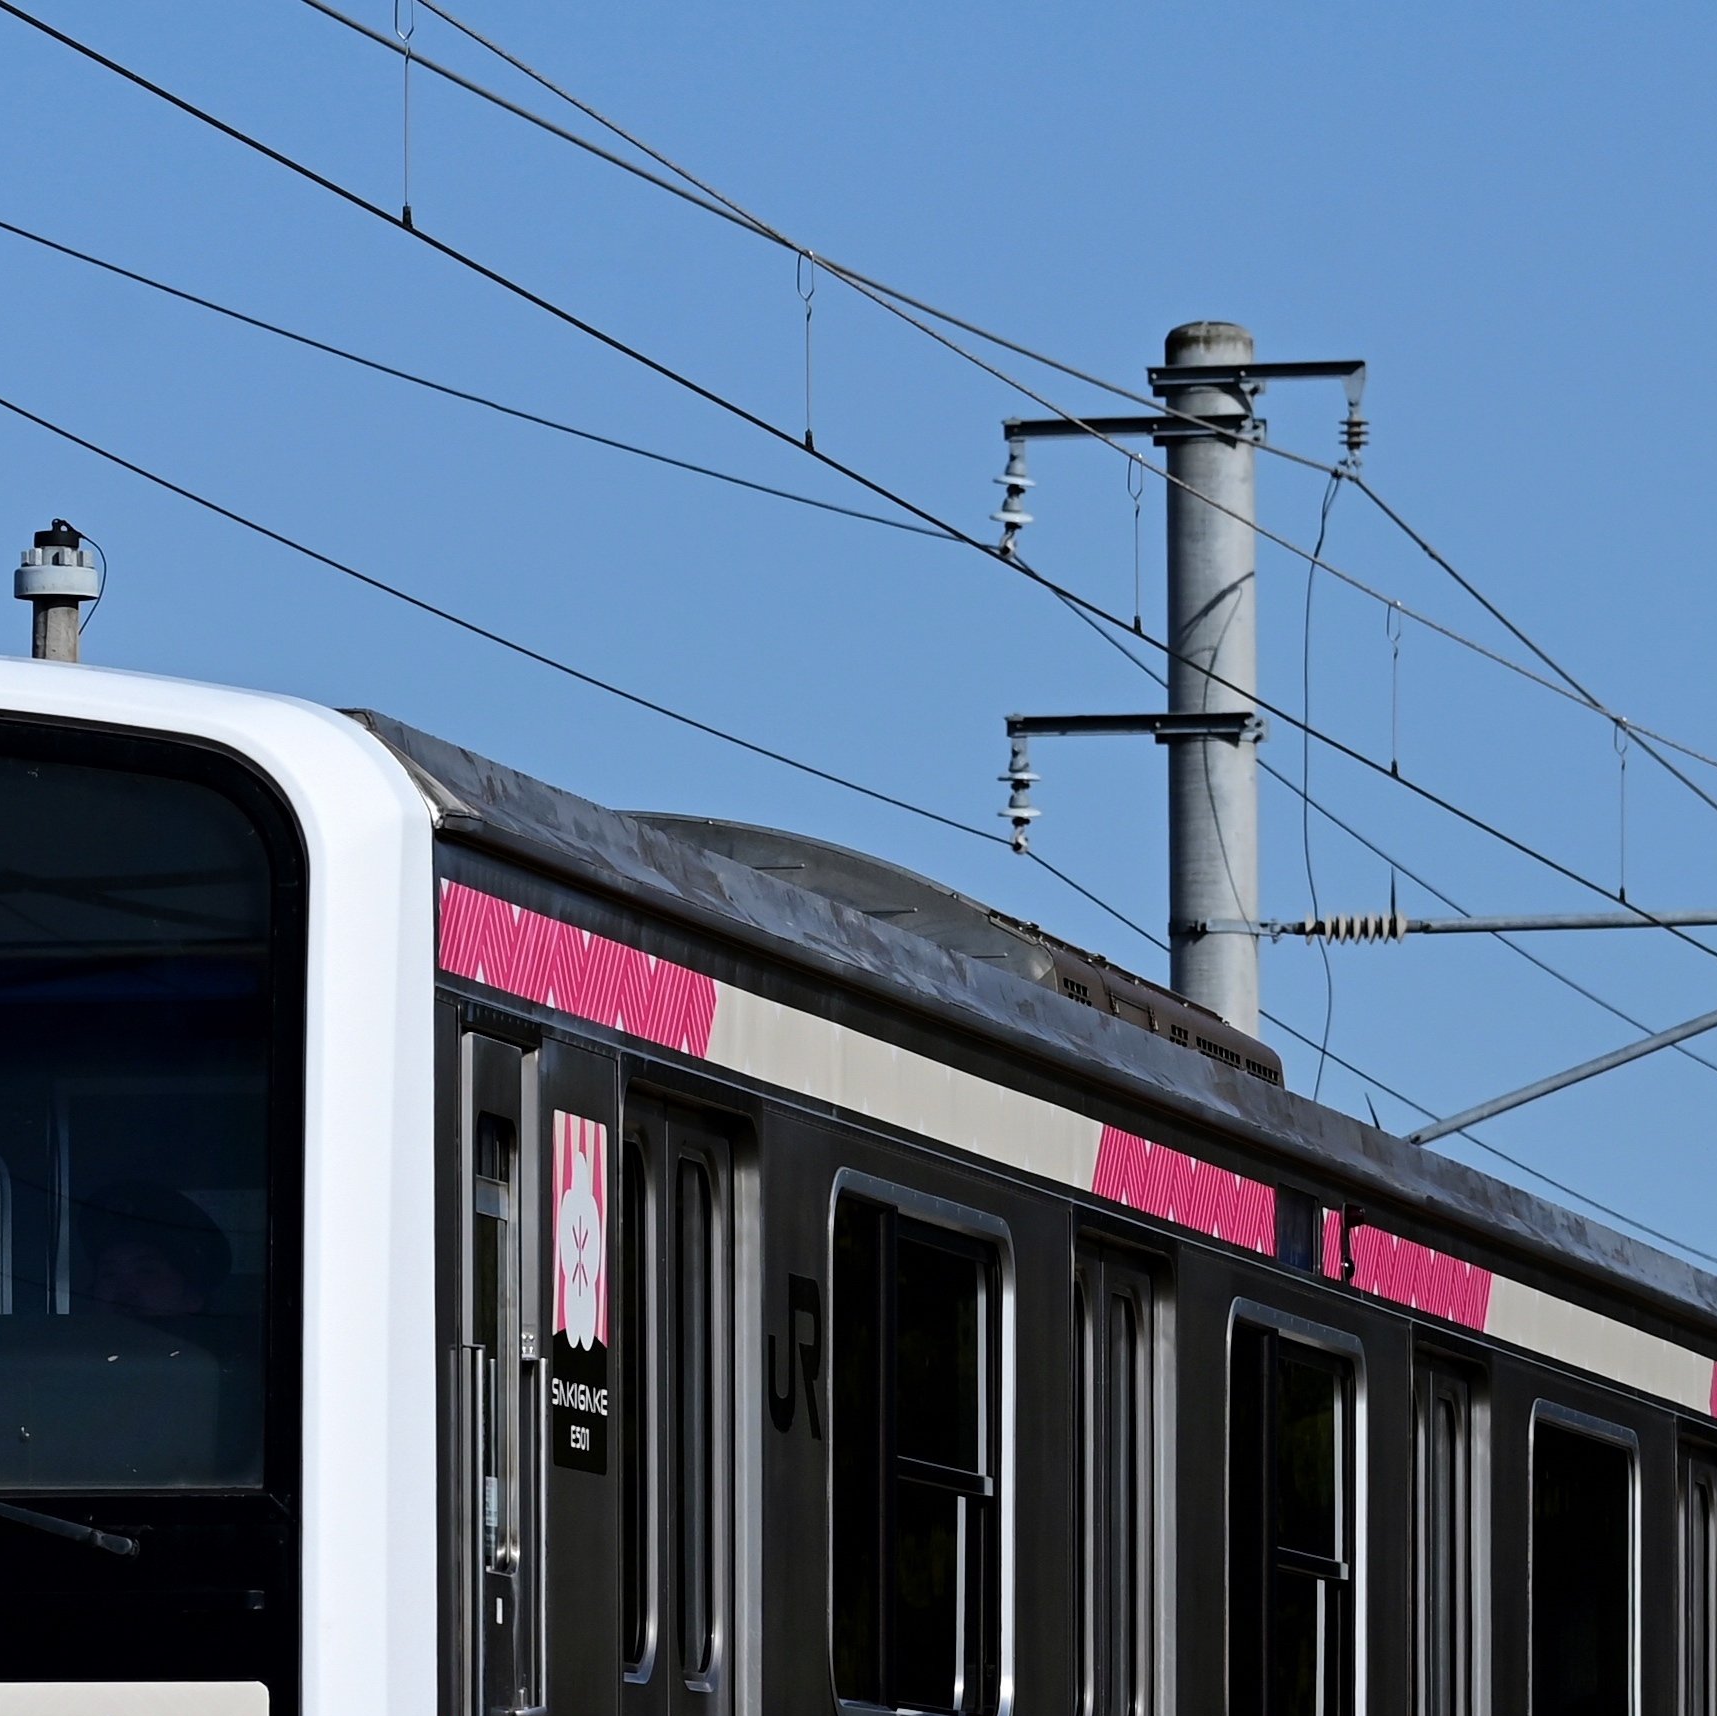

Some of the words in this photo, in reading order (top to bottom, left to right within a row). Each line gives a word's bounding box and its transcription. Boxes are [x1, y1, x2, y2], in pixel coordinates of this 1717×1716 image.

[768, 1273, 822, 1441] JR
[551, 1377, 609, 1417] SAKIGAKE
[570, 1425, 590, 1452] E501
